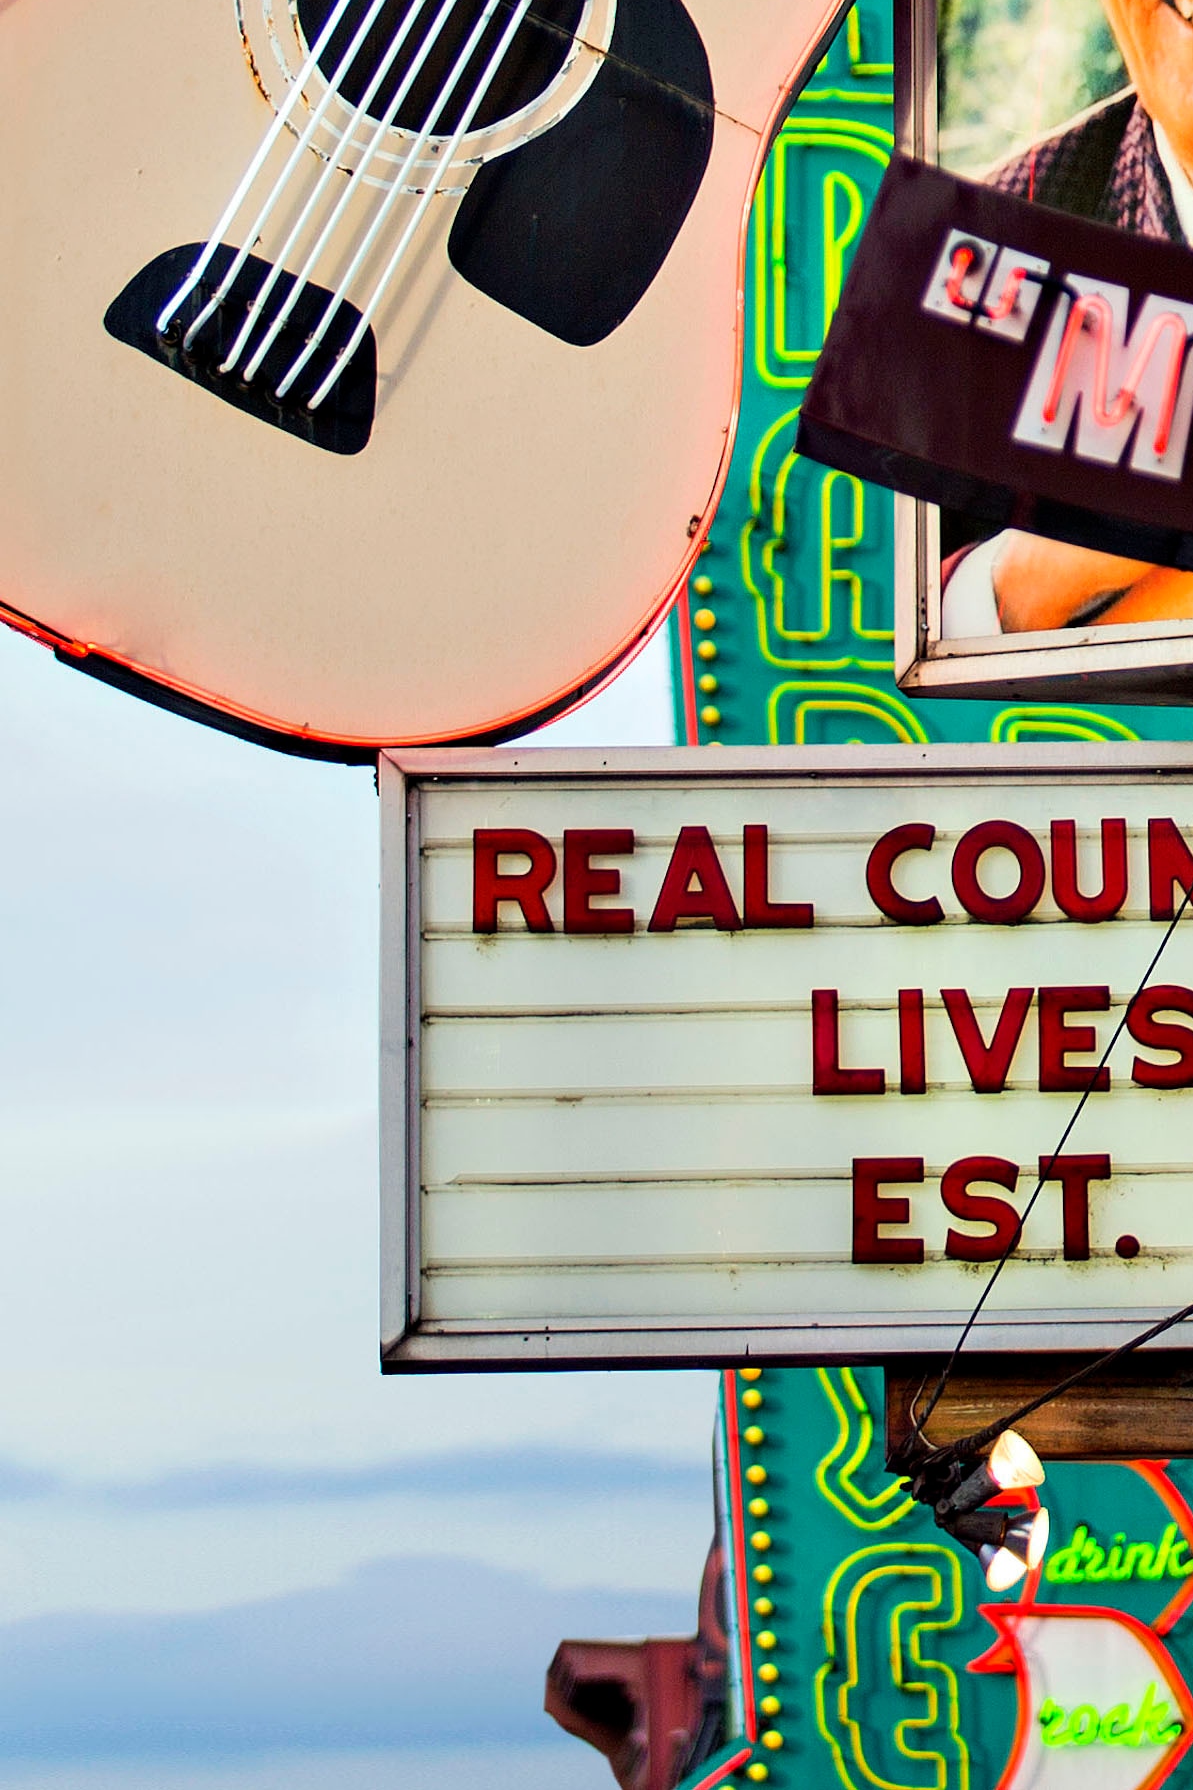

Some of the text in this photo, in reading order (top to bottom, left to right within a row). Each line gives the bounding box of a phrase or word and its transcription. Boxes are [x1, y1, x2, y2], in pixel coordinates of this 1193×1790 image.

[471, 824, 815, 935] REAL
[851, 1154, 1141, 1266] EST.
[1040, 1681, 1184, 1748] rock
